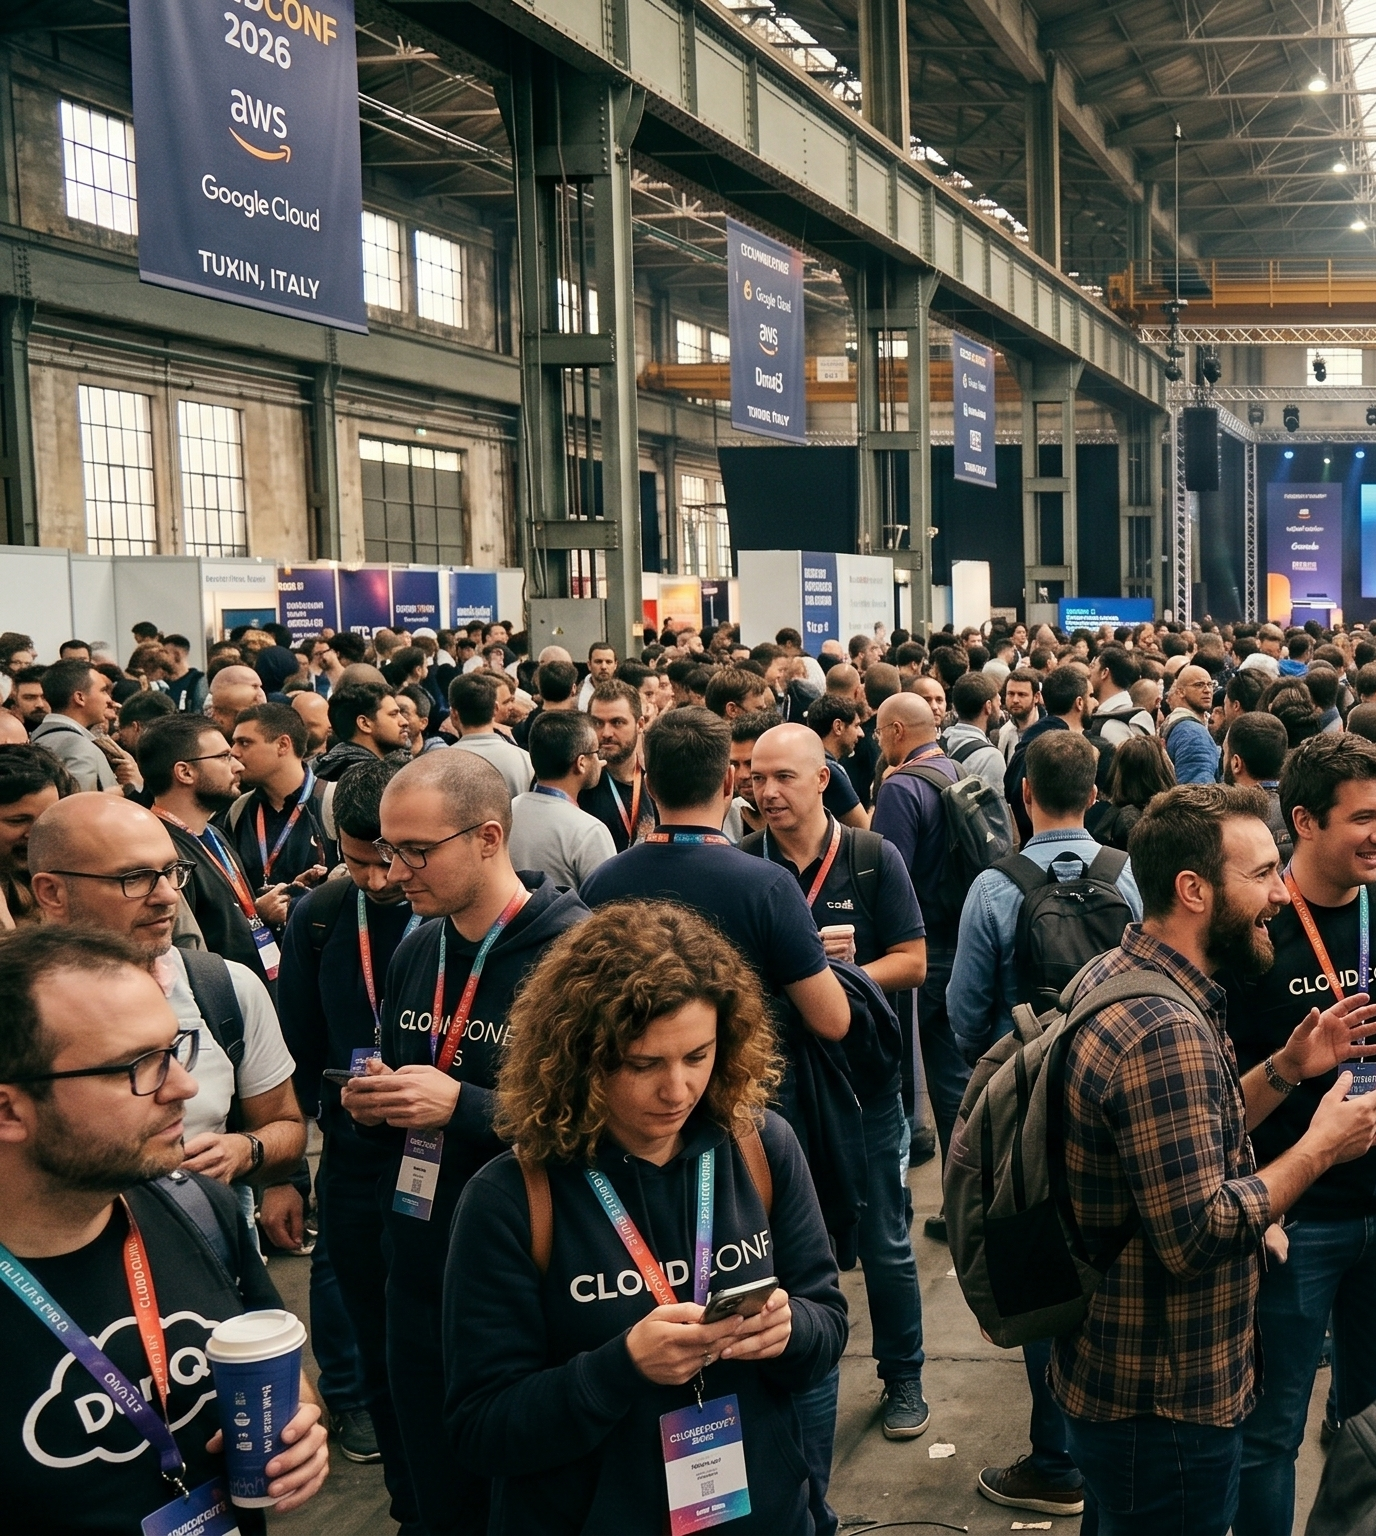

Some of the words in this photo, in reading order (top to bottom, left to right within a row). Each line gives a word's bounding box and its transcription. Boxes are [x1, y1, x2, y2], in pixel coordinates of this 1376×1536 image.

[223, 11, 292, 70] 2026
[230, 88, 288, 139] aws
[201, 173, 270, 218] Google
[271, 196, 320, 232] Cloud
[198, 249, 265, 291] TUXIN,
[270, 268, 320, 300] ITALY
